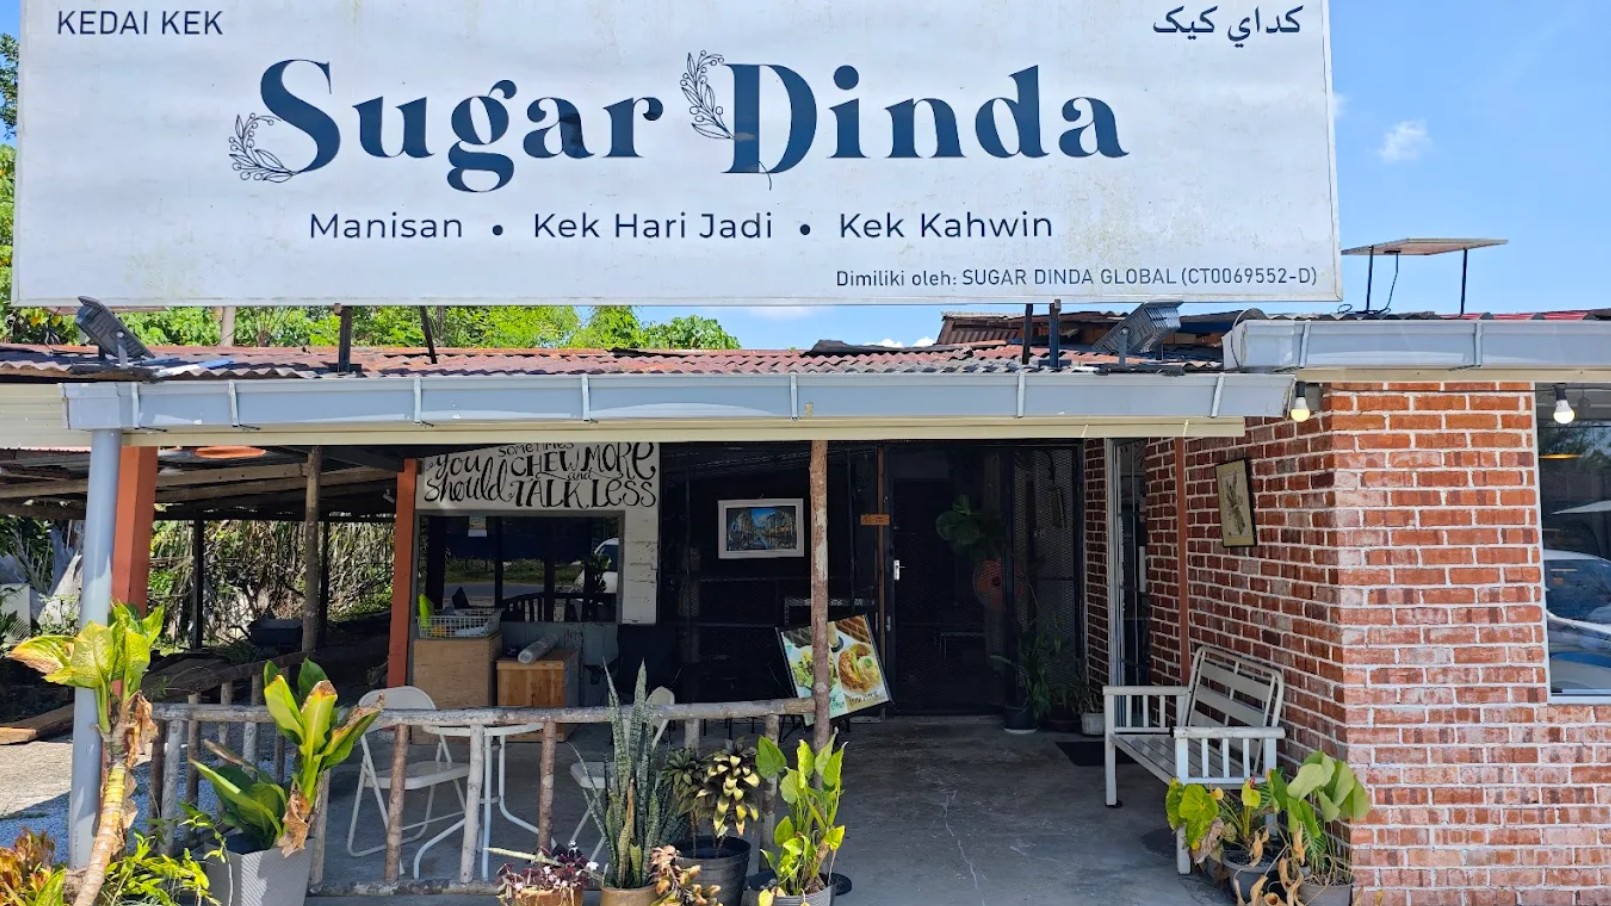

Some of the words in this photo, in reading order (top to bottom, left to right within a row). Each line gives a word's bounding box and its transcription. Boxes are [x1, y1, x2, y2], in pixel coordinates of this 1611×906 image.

[57, 10, 148, 35] KEDAI
[161, 10, 223, 35] KEK
[256, 59, 664, 193] Sugar
[721, 64, 1130, 176] Dinda
[311, 212, 463, 239] Manisan
[535, 212, 600, 239] Kek
[615, 211, 686, 239] Hari
[699, 211, 772, 239] Jadi
[841, 212, 905, 239] Kek
[921, 211, 1053, 239] Kahwin
[836, 270, 905, 287] Dimiliki
[911, 270, 957, 287] oleh:
[962, 268, 1027, 286] SUGAR
[1034, 268, 1094, 286] DINDA
[1100, 268, 1177, 286] GLOBAL
[1181, 267, 1317, 287] (CT0069552-D)
[510, 449, 580, 477] CHEW
[567, 467, 593, 481] and
